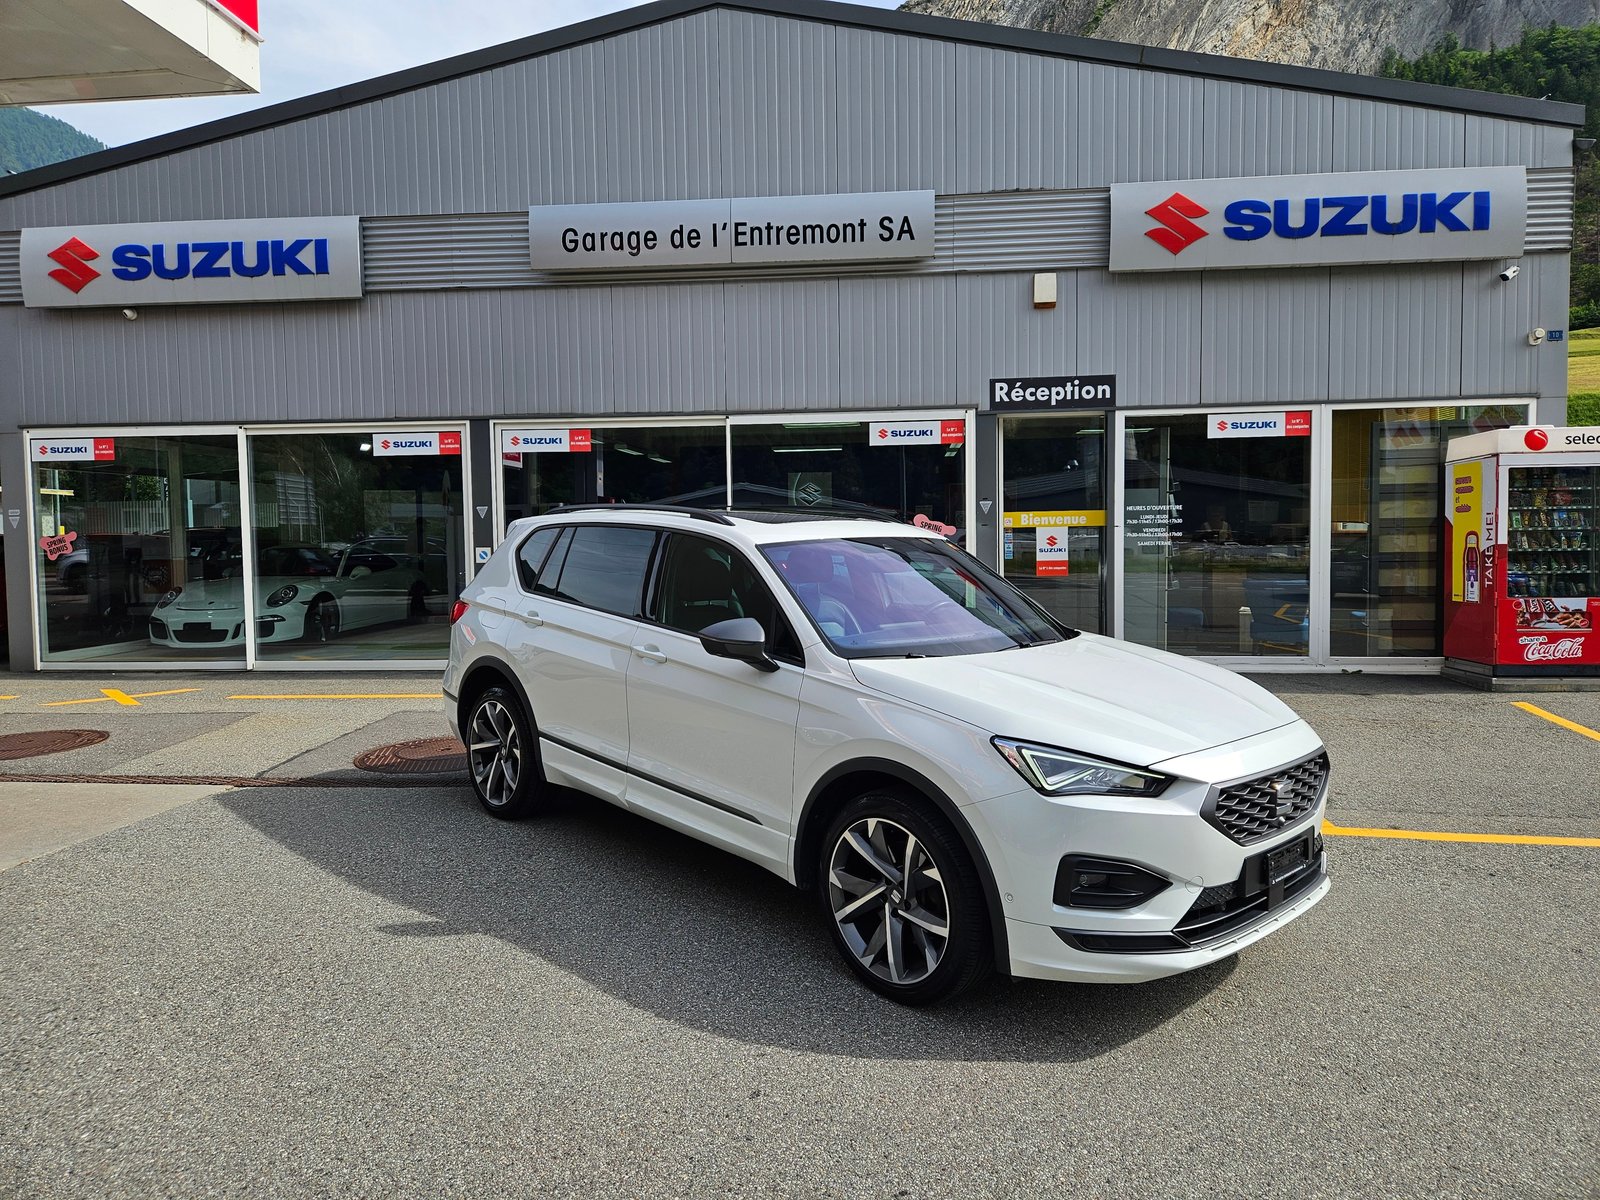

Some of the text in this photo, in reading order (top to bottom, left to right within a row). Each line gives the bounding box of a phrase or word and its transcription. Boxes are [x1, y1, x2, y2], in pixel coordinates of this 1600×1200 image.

[1223, 191, 1491, 241] SUZUKI
[561, 227, 658, 257] Garage
[670, 224, 701, 249] de
[878, 215, 915, 242] SA
[112, 238, 330, 281] SUZUKI
[995, 379, 1111, 406] Réception
[1230, 421, 1277, 429] SUZUKI
[920, 521, 942, 532] SPRING
[1020, 514, 1087, 525] Bienvenue
[47, 537, 66, 548] SPRING
[49, 544, 68, 555] BONUS
[1484, 546, 1493, 588] TAKE
